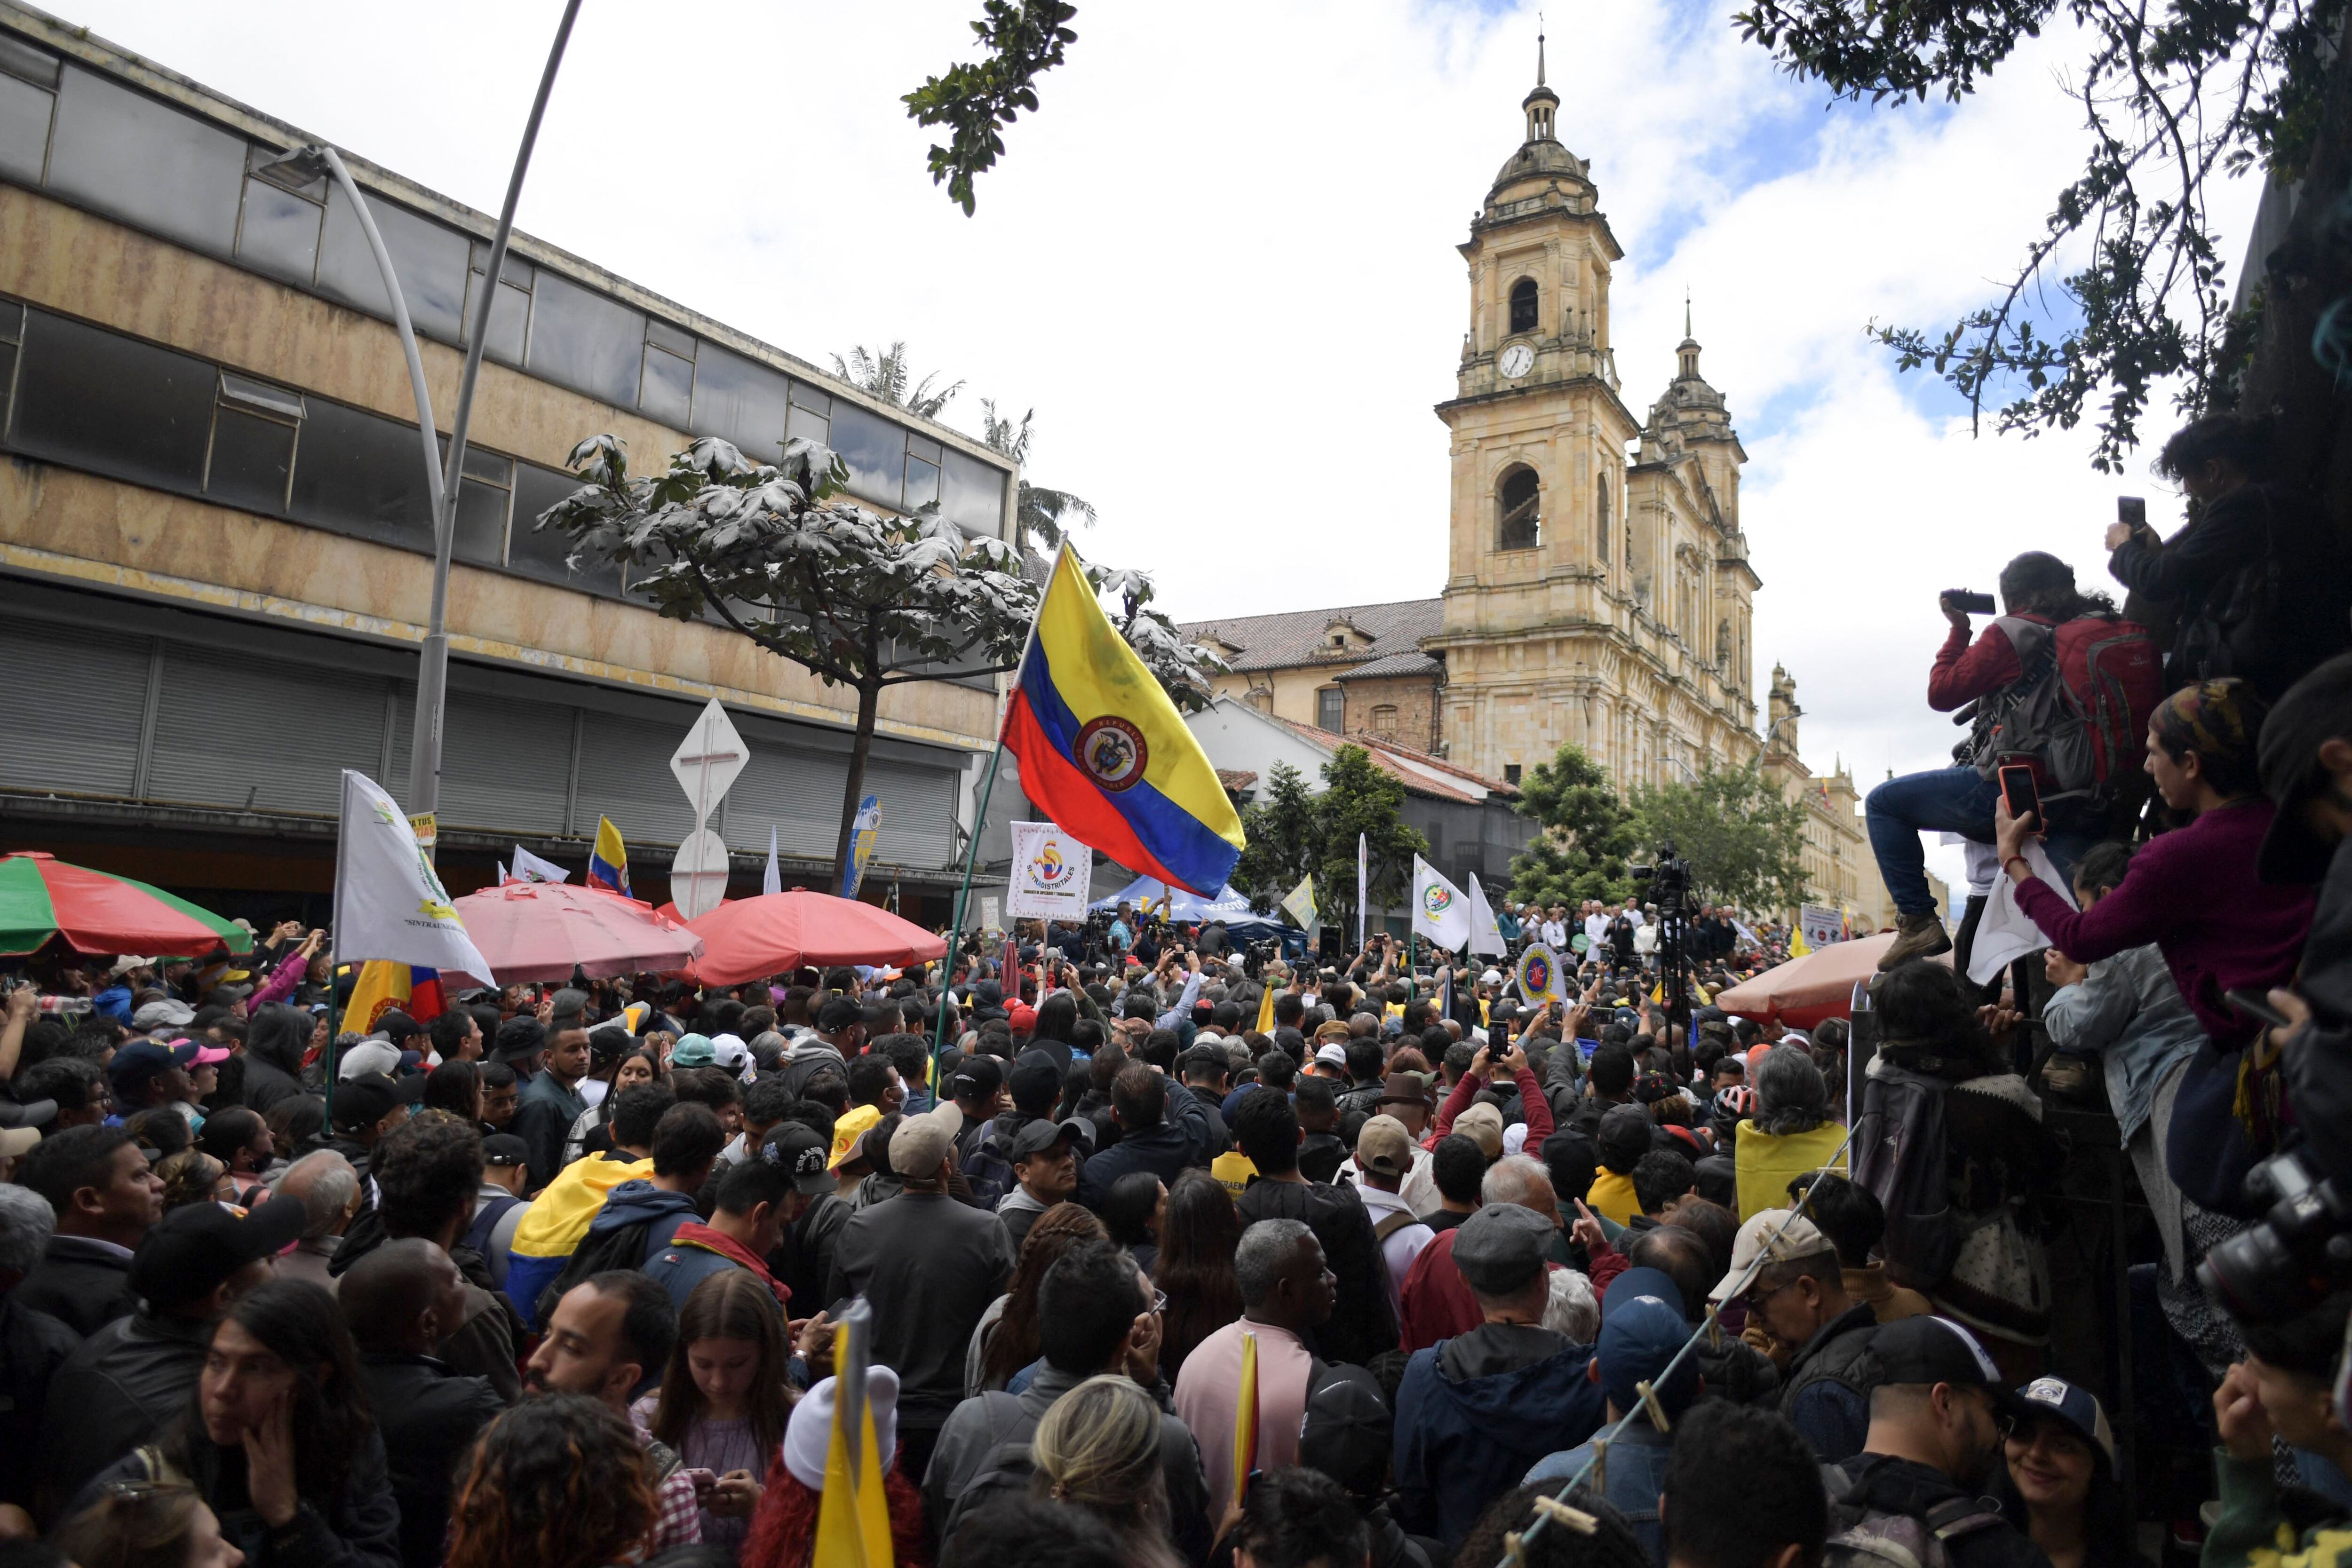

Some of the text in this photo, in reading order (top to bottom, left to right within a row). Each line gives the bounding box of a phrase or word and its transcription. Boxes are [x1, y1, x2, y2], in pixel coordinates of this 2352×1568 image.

[1098, 720, 1144, 755] REPUBLICA
[418, 817, 432, 826] TUS
[1027, 865, 1075, 890] SINTRADISTRITALES
[1526, 965, 1545, 982] CTC
[796, 1154, 807, 1172] LOS
